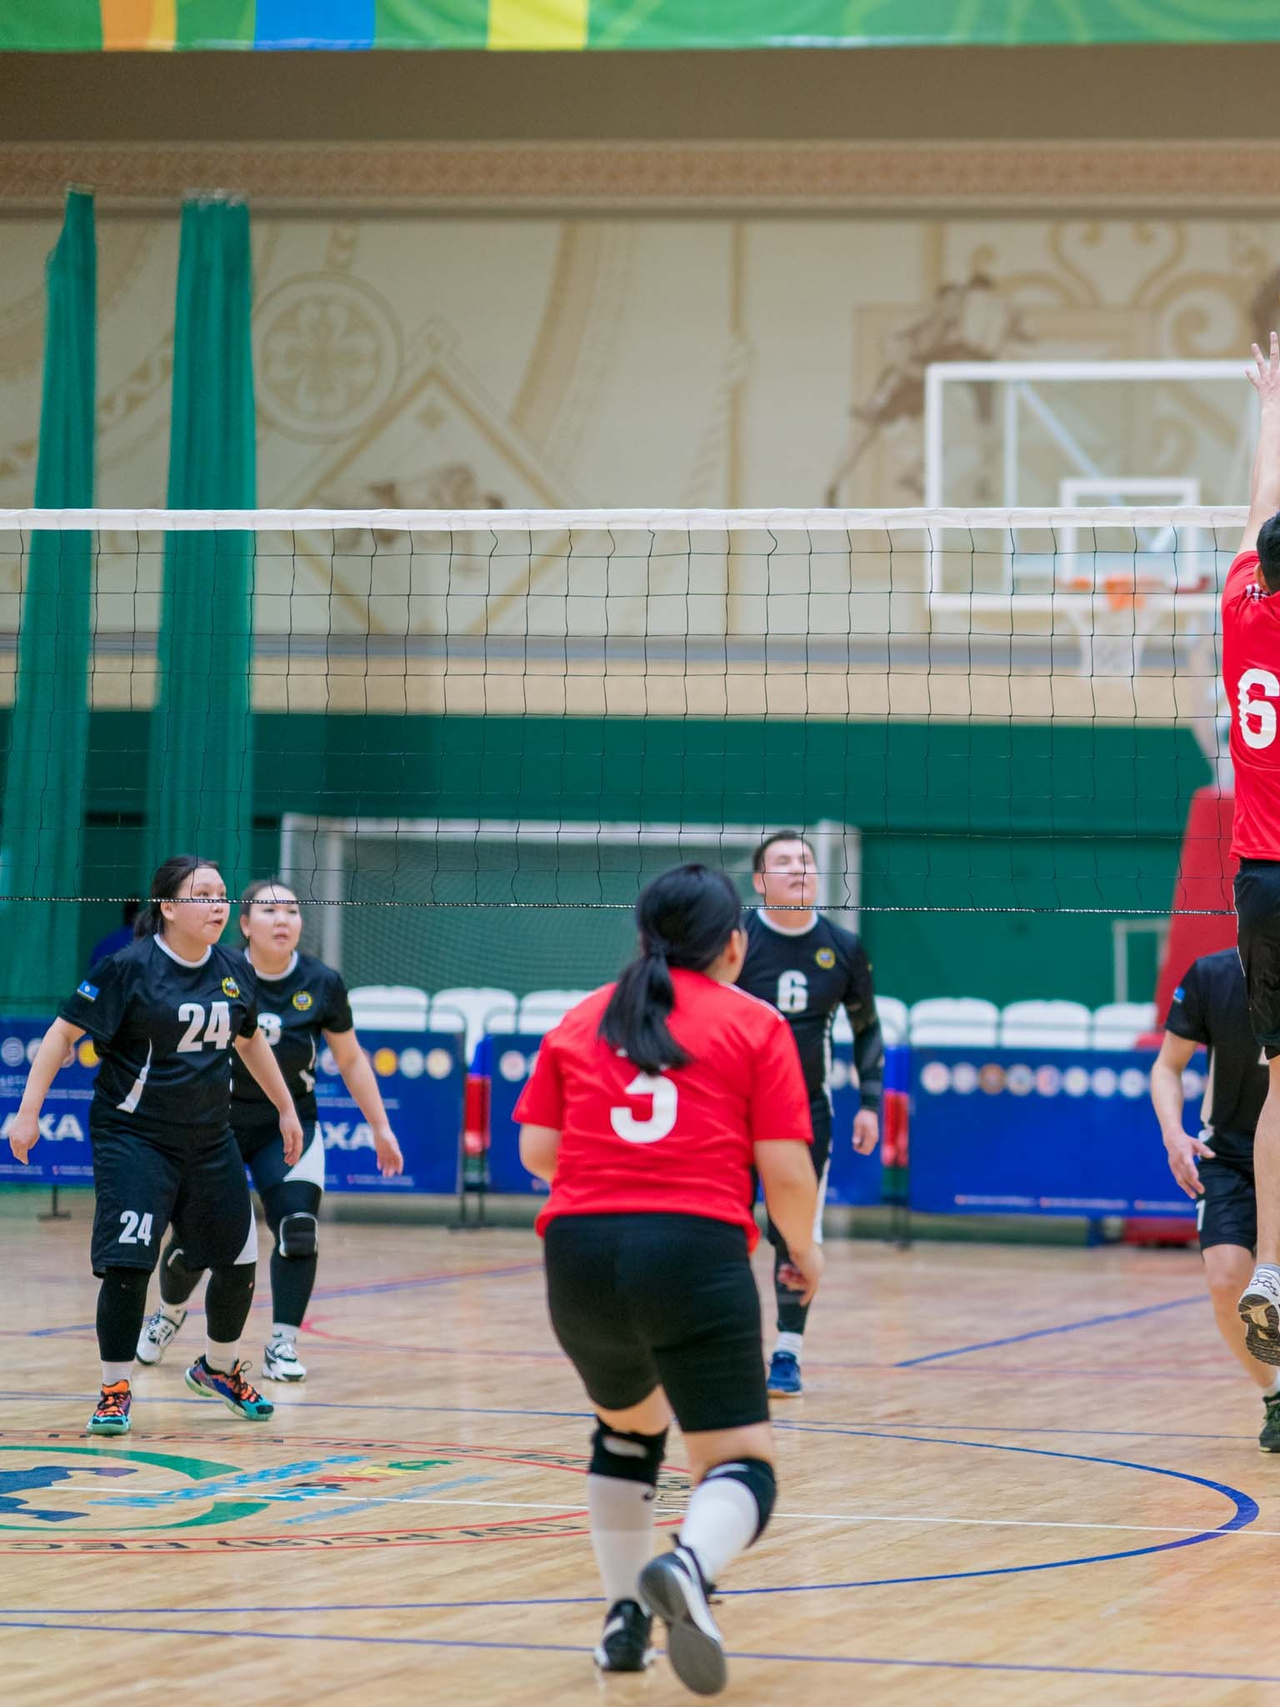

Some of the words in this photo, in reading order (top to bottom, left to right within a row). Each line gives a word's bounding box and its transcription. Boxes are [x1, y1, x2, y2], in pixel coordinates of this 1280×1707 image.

[777, 970, 808, 1014] 6
[177, 1001, 232, 1053] 24
[118, 1209, 154, 1247] 24
